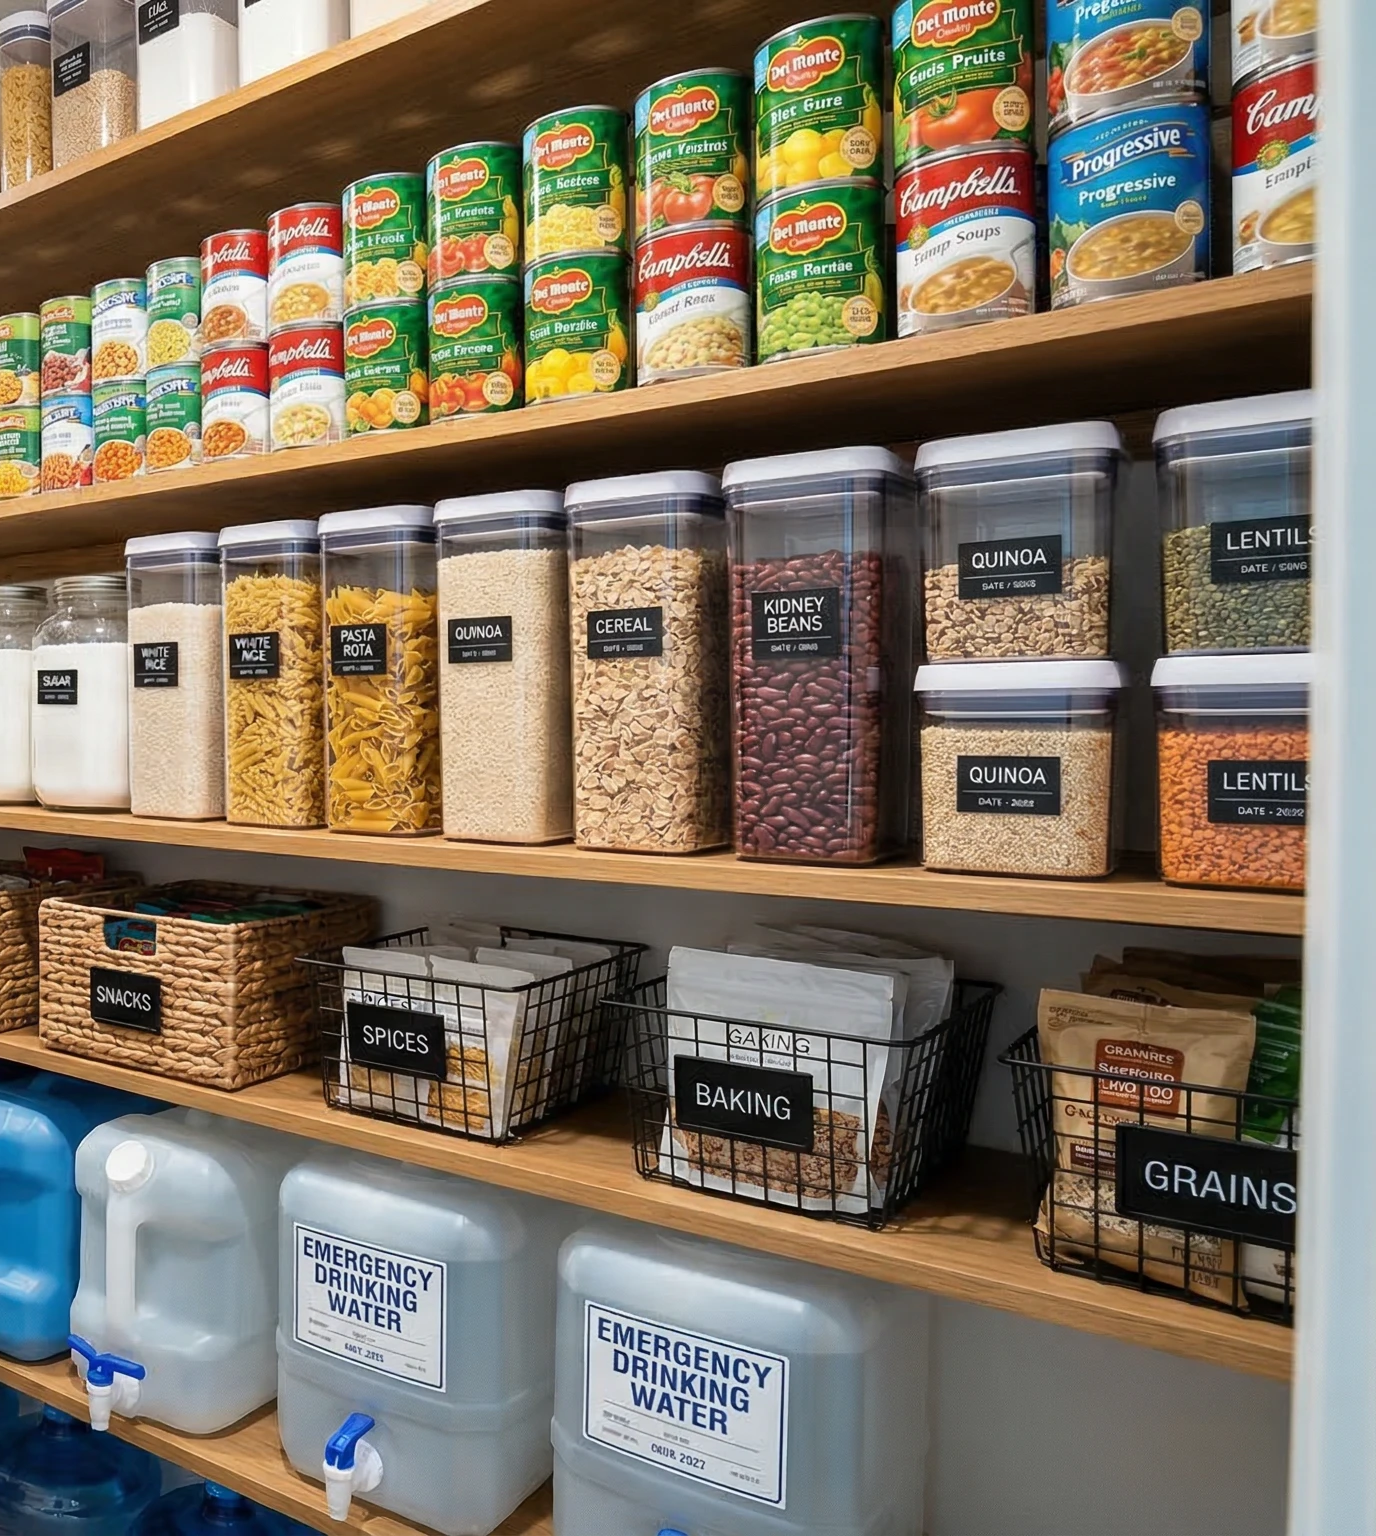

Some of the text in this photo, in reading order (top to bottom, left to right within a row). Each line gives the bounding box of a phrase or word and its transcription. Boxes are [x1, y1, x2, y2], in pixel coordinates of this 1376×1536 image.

[916, 0, 995, 36] Del Monte
[792, 48, 840, 71] Monte
[952, 48, 1006, 69] Pruits
[1072, 127, 1181, 181] Progressive
[1079, 172, 1176, 206] Progressive
[955, 225, 1002, 246] Soups
[971, 548, 1047, 569] QUINOA
[763, 596, 824, 615] KIDNEY
[340, 628, 376, 643] PASTA
[595, 616, 653, 635] CEREAL
[767, 615, 823, 634] BEANS
[343, 643, 374, 657] ROTA
[969, 766, 1047, 785] QUINOA
[978, 797, 1002, 807] DATE
[1237, 806, 1266, 816] DATE
[95, 985, 152, 1012] SNACKS
[362, 1024, 429, 1055] SPICES
[696, 1082, 792, 1121] BAKING
[1144, 1160, 1297, 1215] GRAINS
[303, 1236, 434, 1292] EMERGENCY
[315, 1262, 418, 1313] DRINKING
[327, 1290, 402, 1334] WATER
[597, 1316, 773, 1390] EMERGENCY
[613, 1348, 750, 1414] DRINKING
[630, 1381, 729, 1436] WATER
